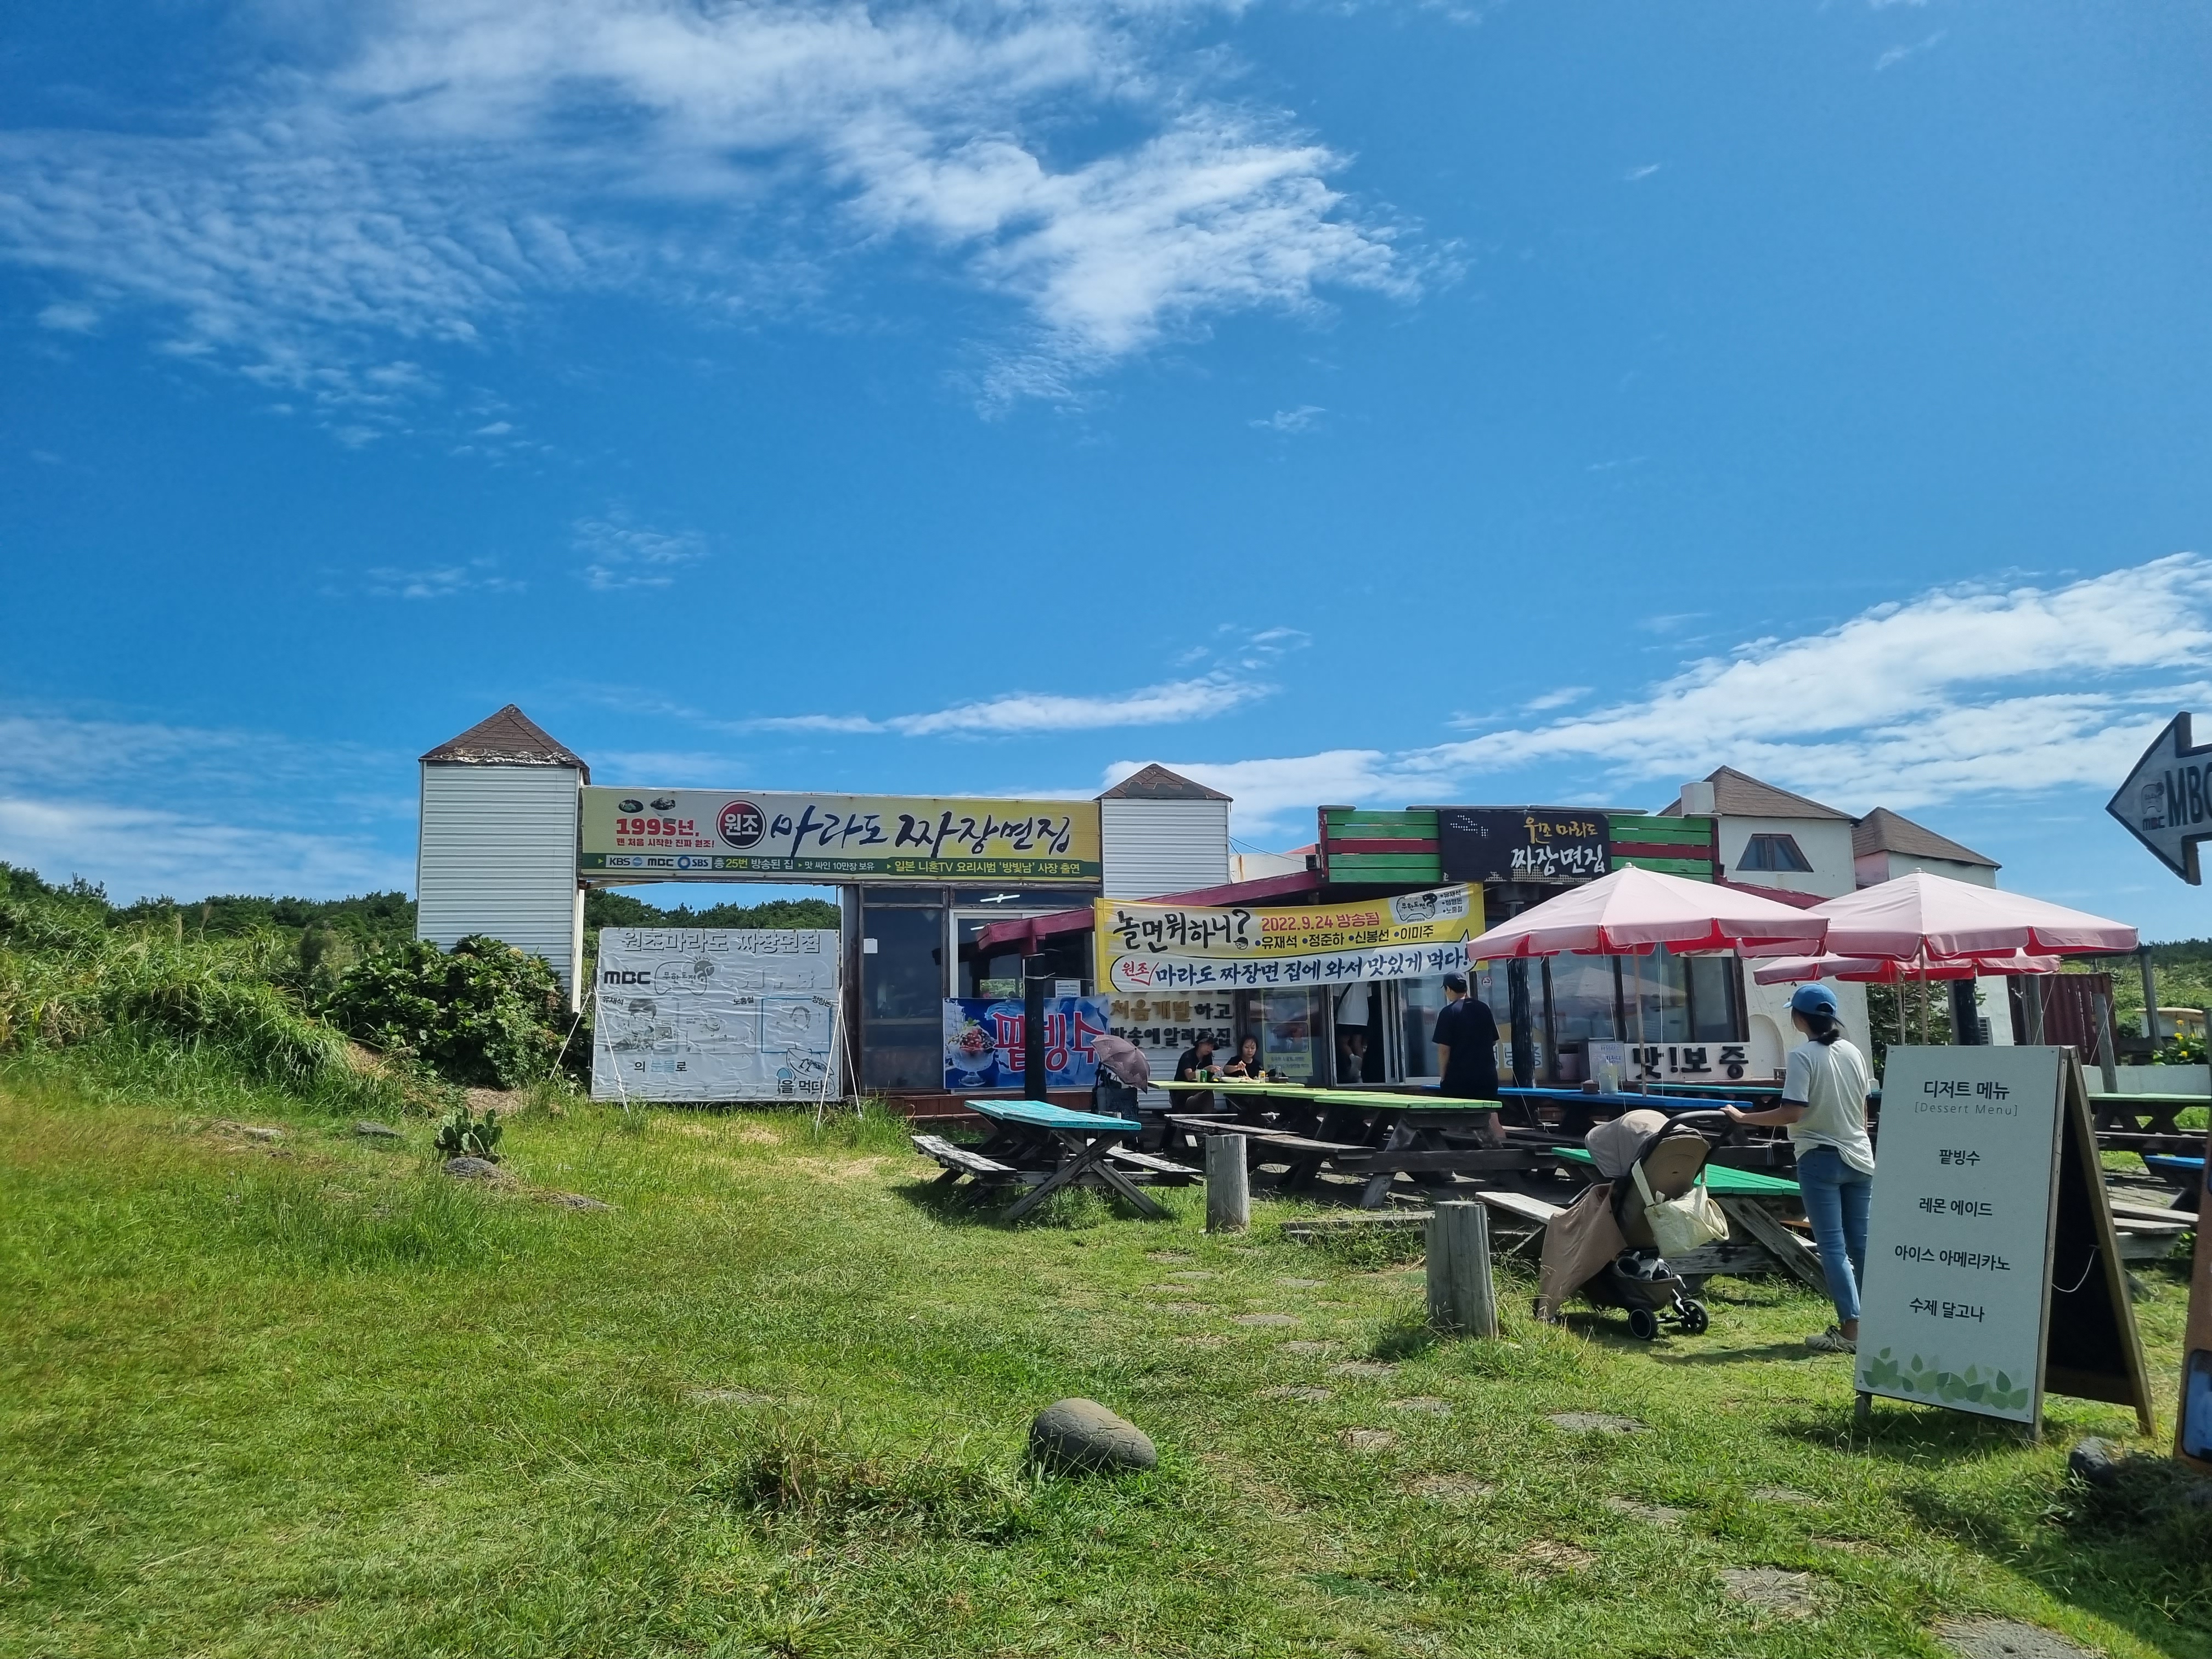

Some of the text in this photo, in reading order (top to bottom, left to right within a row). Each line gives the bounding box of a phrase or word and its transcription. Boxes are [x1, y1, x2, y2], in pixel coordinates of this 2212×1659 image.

[725, 814, 759, 836] 원조
[770, 805, 1071, 860] 마라도 짜장면집
[1523, 816, 1598, 844] 원조 마라도
[628, 838, 644, 847] 처음
[648, 839, 672, 847] 시작한
[695, 839, 715, 848] 원조!
[610, 857, 630, 866] KBS
[648, 859, 674, 867] MBC
[751, 859, 780, 870] 방송된
[784, 860, 793, 870] 집
[815, 862, 831, 870] 싸인
[833, 862, 856, 871] 10만장
[859, 862, 874, 871] 보유
[895, 861, 915, 872] 일본
[919, 861, 953, 873] 니혼TV
[956, 862, 996, 873] 요리시범
[1038, 864, 1058, 874] 사장
[1060, 863, 1080, 874] 출연
[1510, 844, 1605, 876] 짜장면집
[1261, 911, 1380, 932] 2022.9.24 방송됨
[1261, 925, 1434, 950] 유재석 정준하 신봉선 이미주
[604, 970, 651, 984] MBC
[1122, 947, 1468, 987] 원조 마라도 짜장면 집에 와서 맛있게 먹다!
[634, 1061, 645, 1073] 의
[1924, 1080, 2010, 1100] 디저트 메뉴
[1939, 1149, 1980, 1166] 팥빙수
[1920, 1198, 1993, 1217] 레몬 에이드
[1895, 1245, 2011, 1271] 아이스 아메리카노
[1909, 1297, 1985, 1323] 수제 달고나
